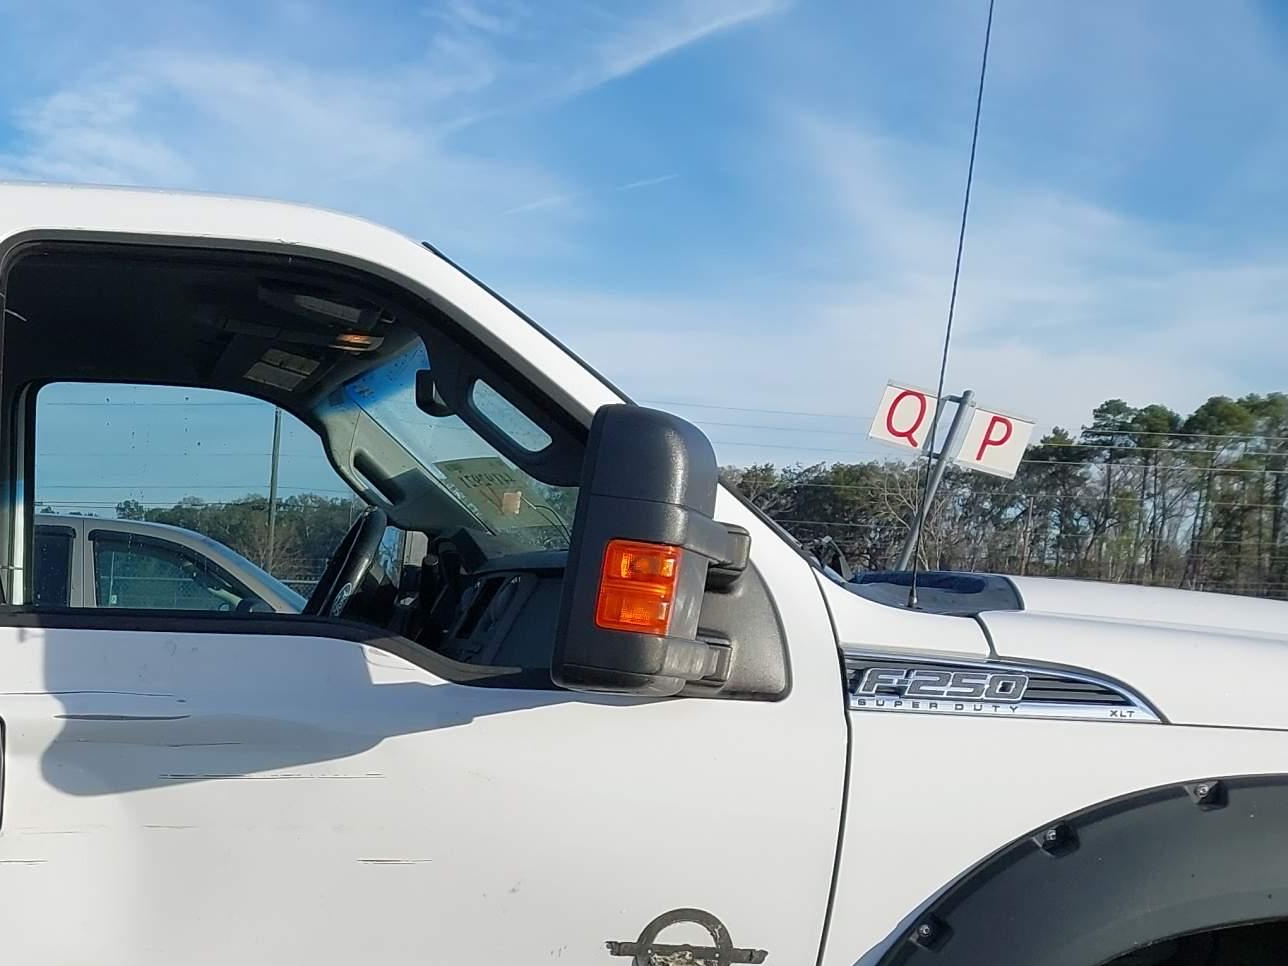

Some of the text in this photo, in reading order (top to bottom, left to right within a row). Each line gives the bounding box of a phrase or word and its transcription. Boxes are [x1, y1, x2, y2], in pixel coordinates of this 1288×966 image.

[886, 389, 927, 448] Q
[975, 415, 1013, 461] P
[854, 667, 1030, 702] F-250
[857, 699, 1020, 714] SUPER DUTY
[1109, 710, 1135, 719] XLT
